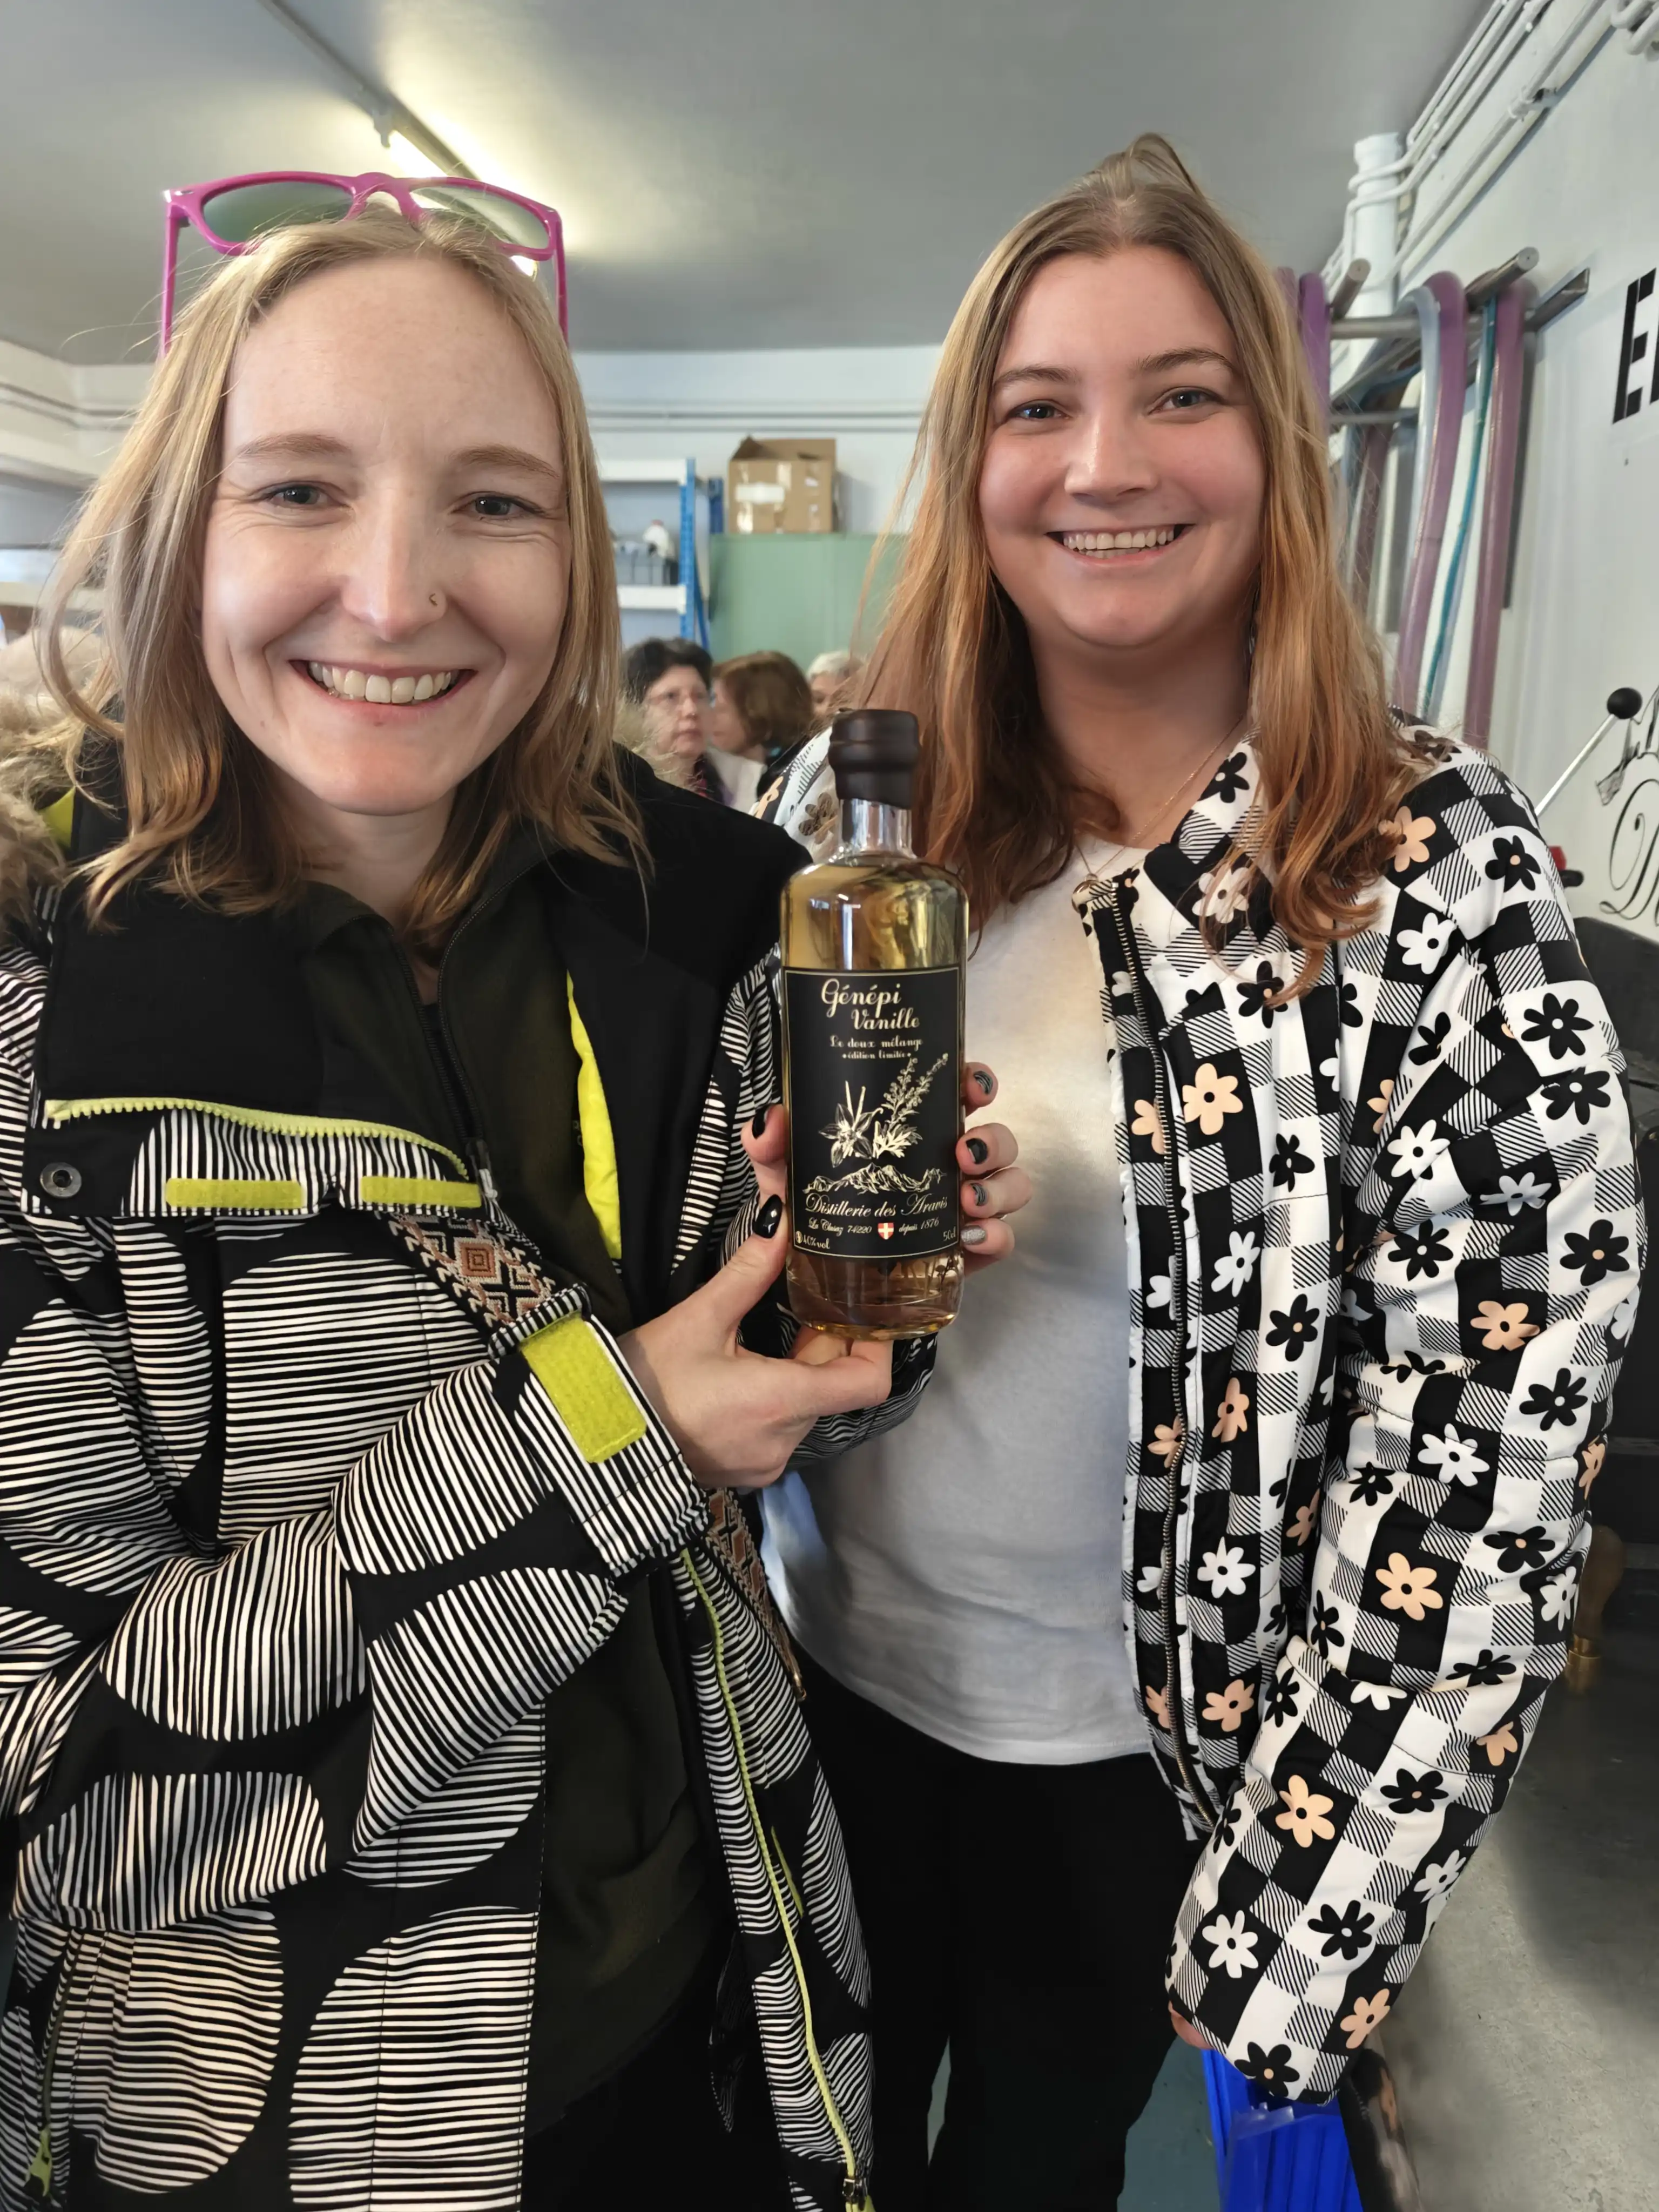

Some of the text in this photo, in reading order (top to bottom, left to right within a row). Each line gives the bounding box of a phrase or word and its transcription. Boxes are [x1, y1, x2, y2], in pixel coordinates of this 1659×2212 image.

[1612, 267, 1659, 425] E
[821, 978, 901, 1018] Génépi
[851, 1007, 919, 1029] Vanille
[830, 1035, 923, 1051] Le doux mélange
[805, 1192, 947, 1217] Distillerie des Aravis
[808, 1217, 819, 1230] La
[847, 1225, 872, 1234] 74220
[899, 1223, 918, 1236] depuis
[920, 1217, 940, 1230] 1876
[943, 1226, 956, 1242] 50cl
